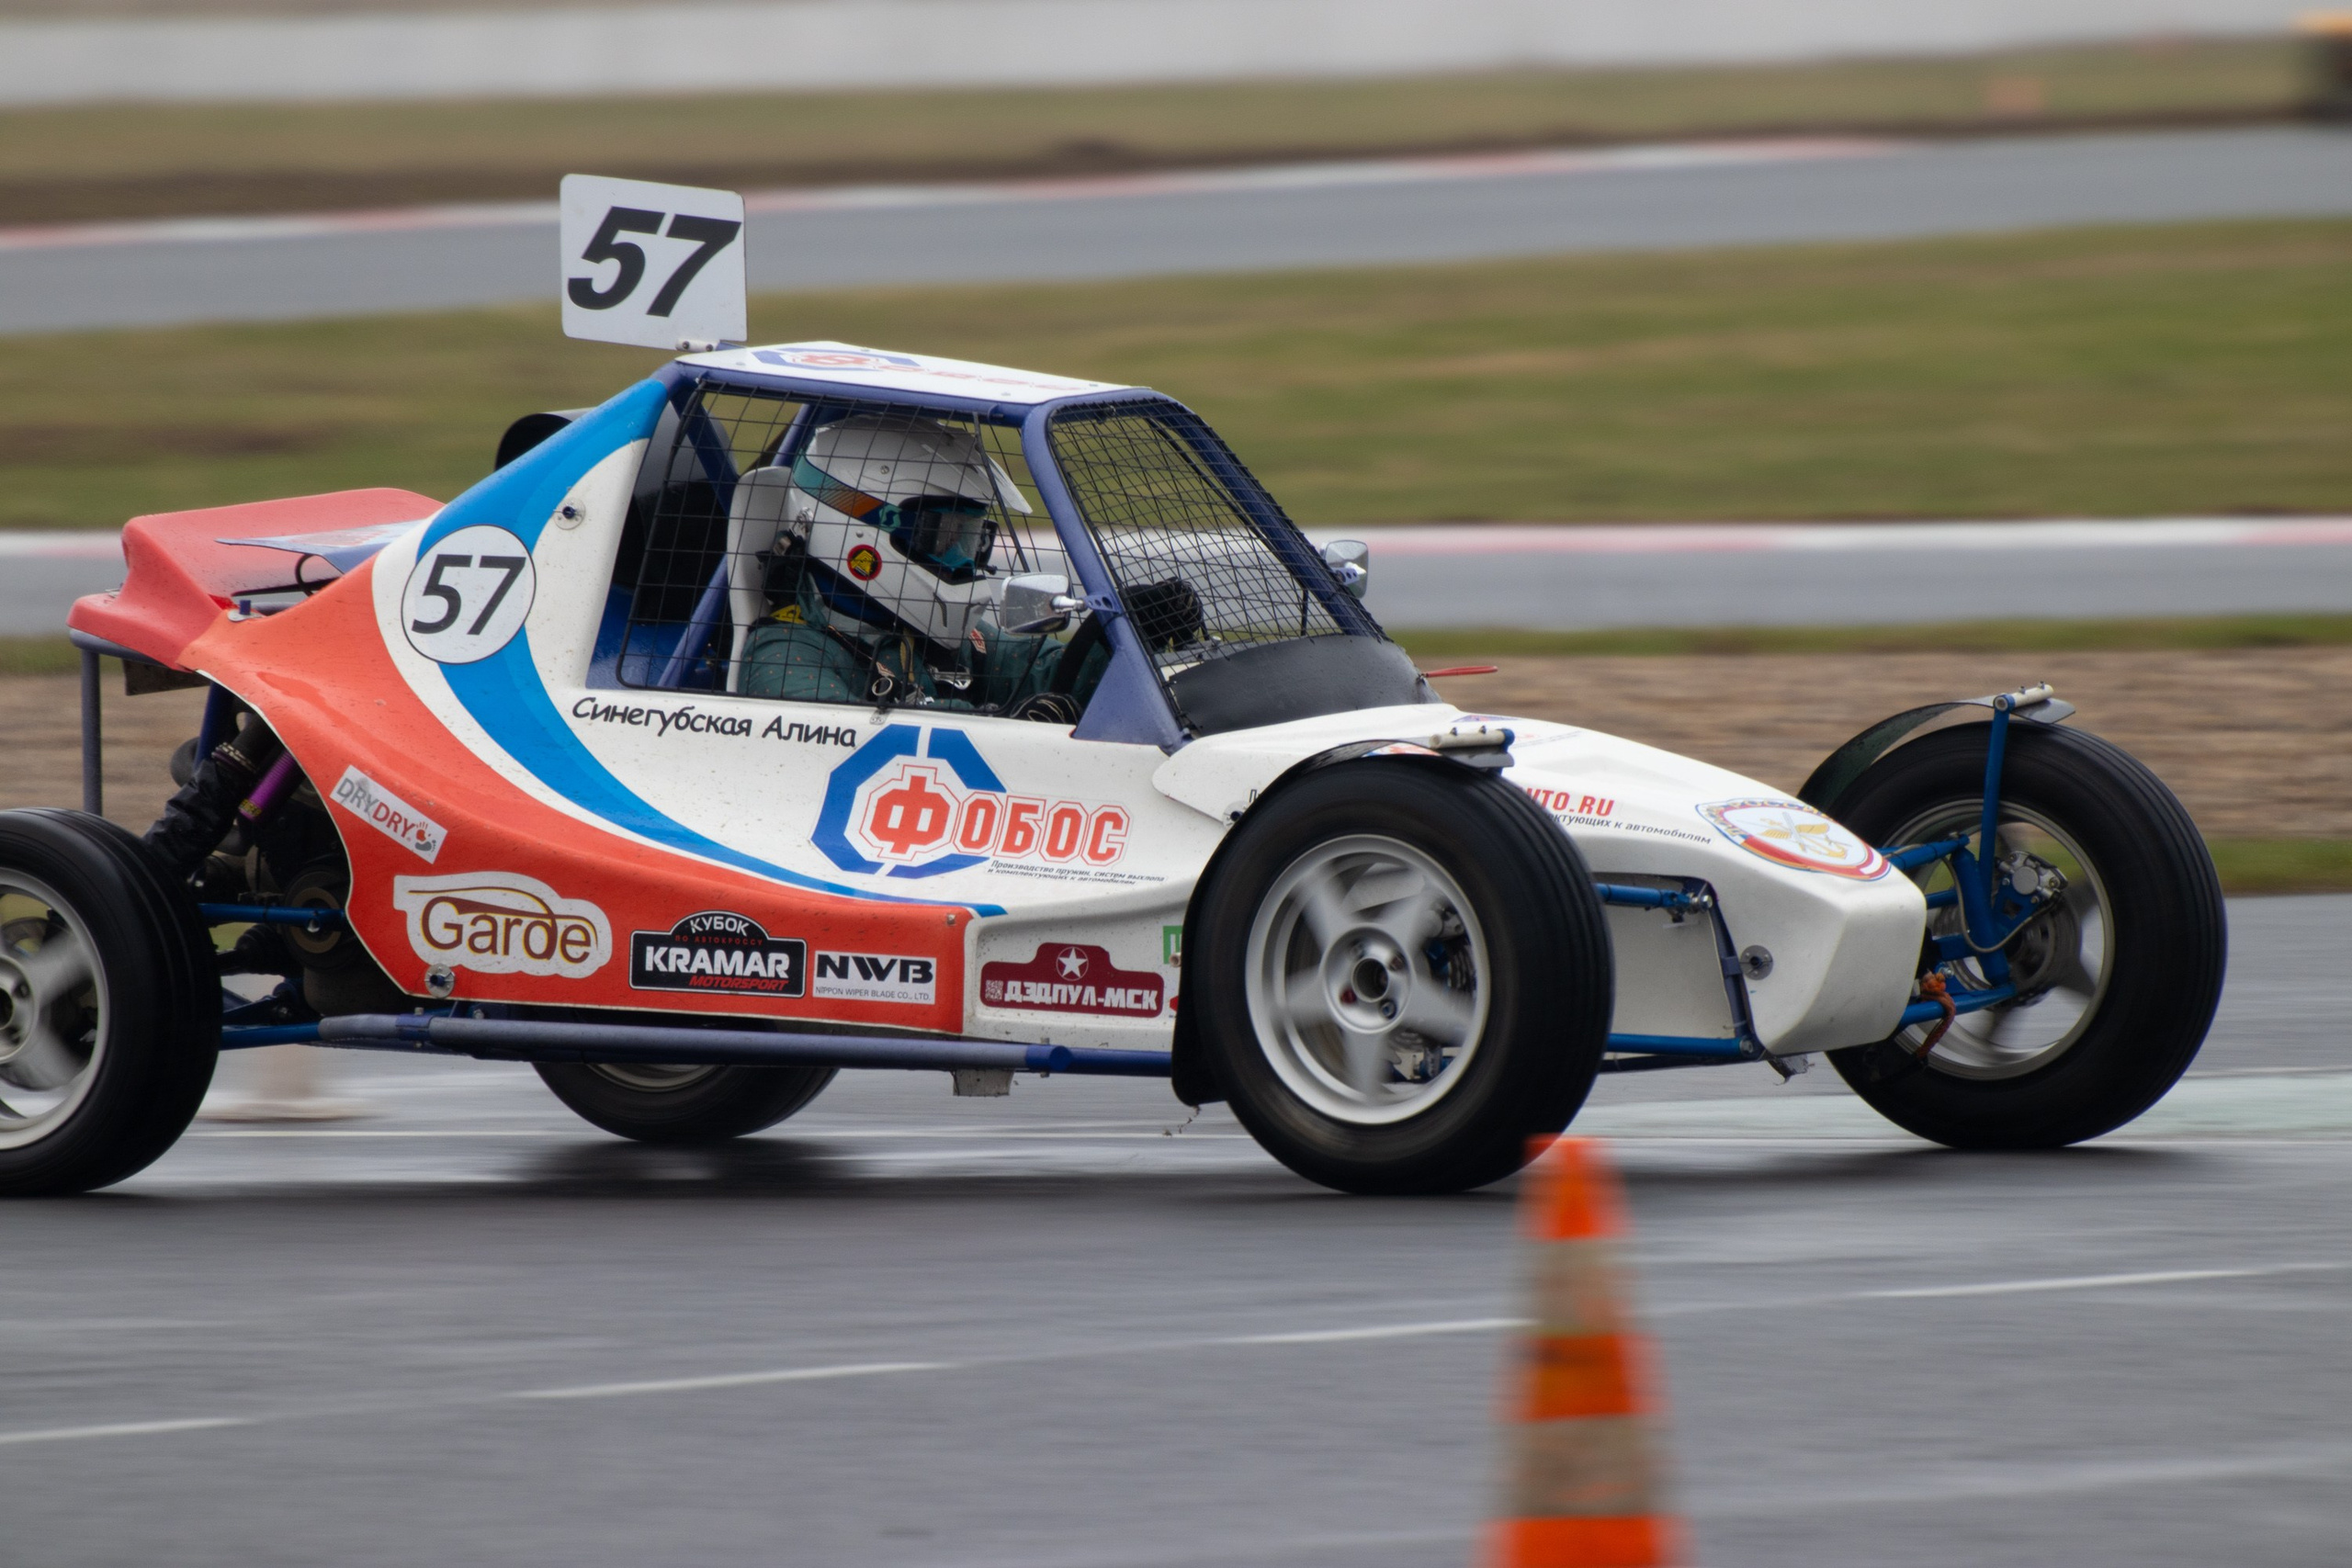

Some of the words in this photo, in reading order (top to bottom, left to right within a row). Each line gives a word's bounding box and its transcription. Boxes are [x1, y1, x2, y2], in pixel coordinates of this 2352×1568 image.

[567, 205, 741, 318] 57
[411, 553, 526, 636] 57
[571, 697, 752, 737] Синегубская
[762, 716, 857, 748] Алина
[336, 777, 415, 839] DRYDRY
[859, 764, 1130, 866] ФОБОС
[1613, 821, 1623, 829] к
[1625, 823, 1712, 845] автомобилям
[990, 860, 1055, 874] Производство
[1093, 871, 1126, 879] систем
[420, 895, 596, 964] Garde
[674, 934, 689, 942] ПО
[694, 936, 763, 946] АВТОКРОССУ
[689, 916, 750, 937] КУБОК
[645, 946, 790, 979] KRAMAR
[816, 953, 933, 984] NWB
[689, 976, 790, 991] MOTORSPORT
[815, 987, 843, 996] NIPPON
[845, 988, 869, 997] WIPER
[870, 990, 896, 999] BLADE
[914, 992, 932, 1001] LTD.
[1004, 980, 1158, 1011] ДЭДПУЛ-МСК
